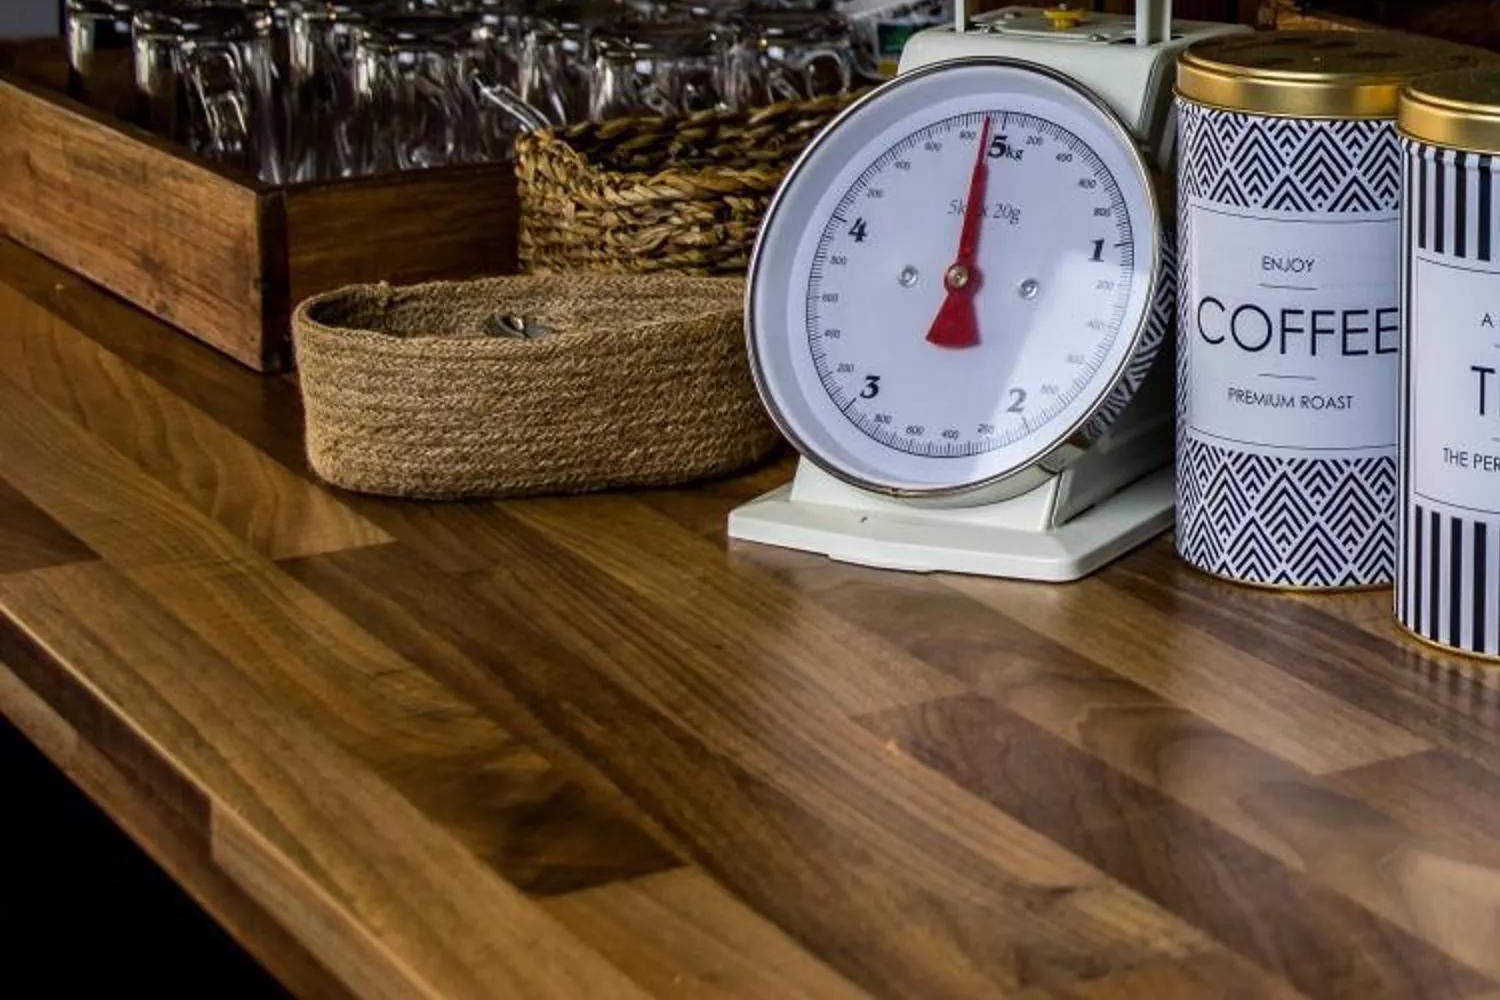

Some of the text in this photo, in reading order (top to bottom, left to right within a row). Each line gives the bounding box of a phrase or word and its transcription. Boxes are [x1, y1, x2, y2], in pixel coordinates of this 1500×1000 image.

[987, 135, 1024, 161] 5kg
[993, 201, 1021, 225] 20g
[848, 216, 868, 242] 4
[1088, 238, 1105, 262] 1
[1261, 256, 1315, 272] ENJOY
[1197, 296, 1398, 356] COFFEE
[1481, 313, 1494, 328] A
[859, 375, 880, 399] 3
[1227, 387, 1355, 410] PREMIUM ROAST
[1007, 388, 1027, 413] 2
[1443, 447, 1469, 467] THE
